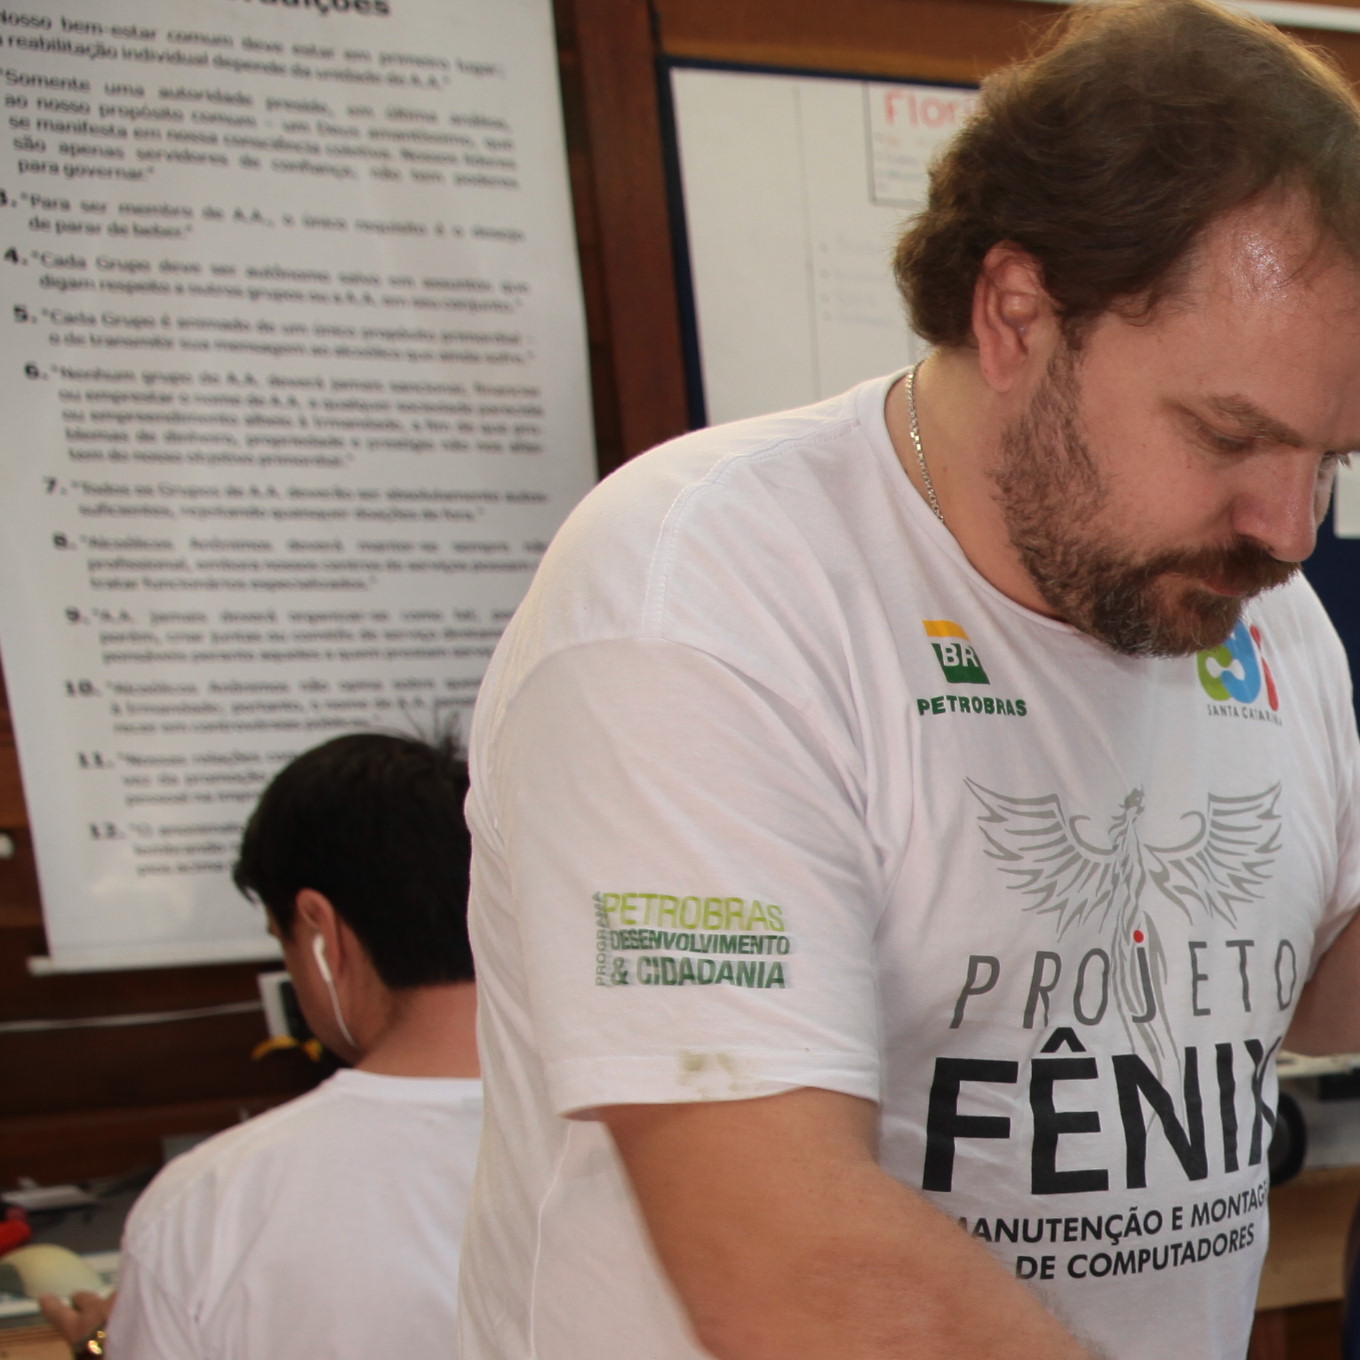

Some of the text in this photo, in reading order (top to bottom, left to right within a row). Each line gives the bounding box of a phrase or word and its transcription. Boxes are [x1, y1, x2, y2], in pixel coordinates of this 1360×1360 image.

[940, 645, 979, 668] BR
[917, 695, 1027, 717] PETROBRAS
[1208, 703, 1239, 718] SANTA
[602, 892, 785, 932] PETROBRAS
[609, 928, 791, 956] DESENVOLVIMENTO
[609, 956, 786, 989] & CIDADANIA
[922, 1027, 1282, 1195] FÊNIX
[1172, 1206, 1183, 1231] E
[1016, 1223, 1255, 1280] DE COMPUTADORES
